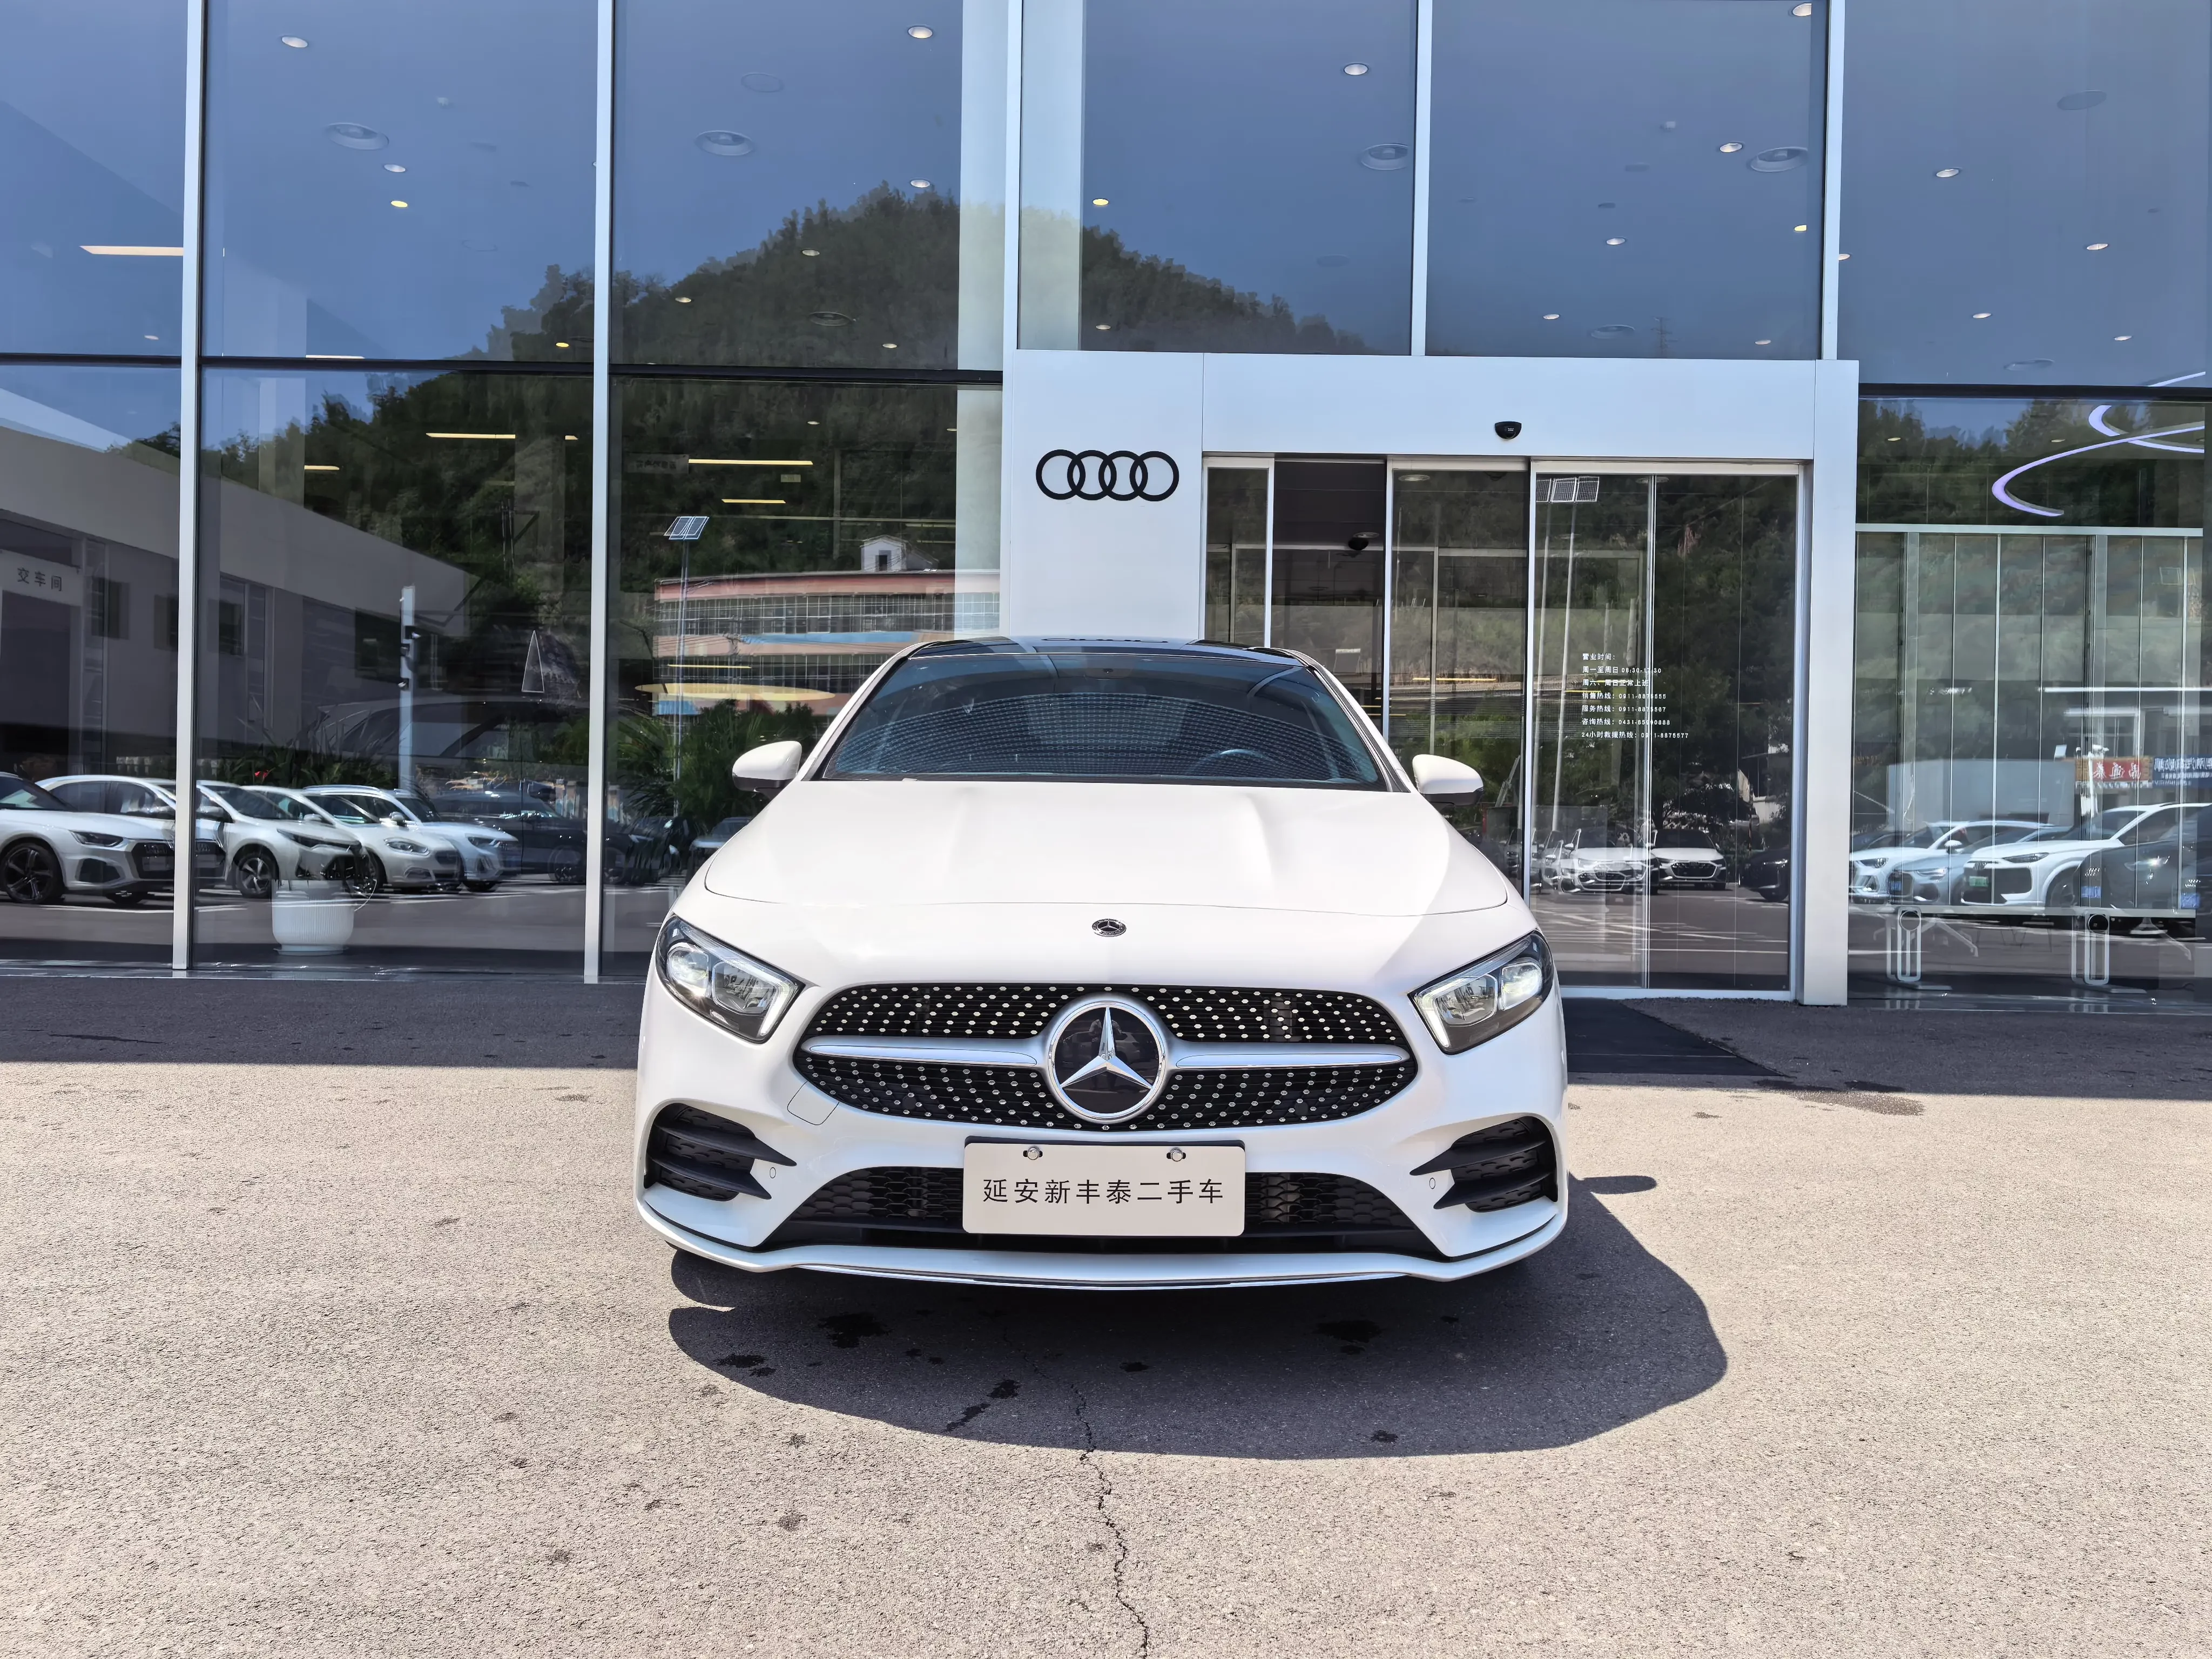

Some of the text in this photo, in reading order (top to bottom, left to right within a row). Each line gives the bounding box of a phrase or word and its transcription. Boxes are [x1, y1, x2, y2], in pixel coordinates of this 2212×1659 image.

[17, 567, 63, 592] 交车间
[983, 1178, 1224, 1204] 延安新丰泰二手车
